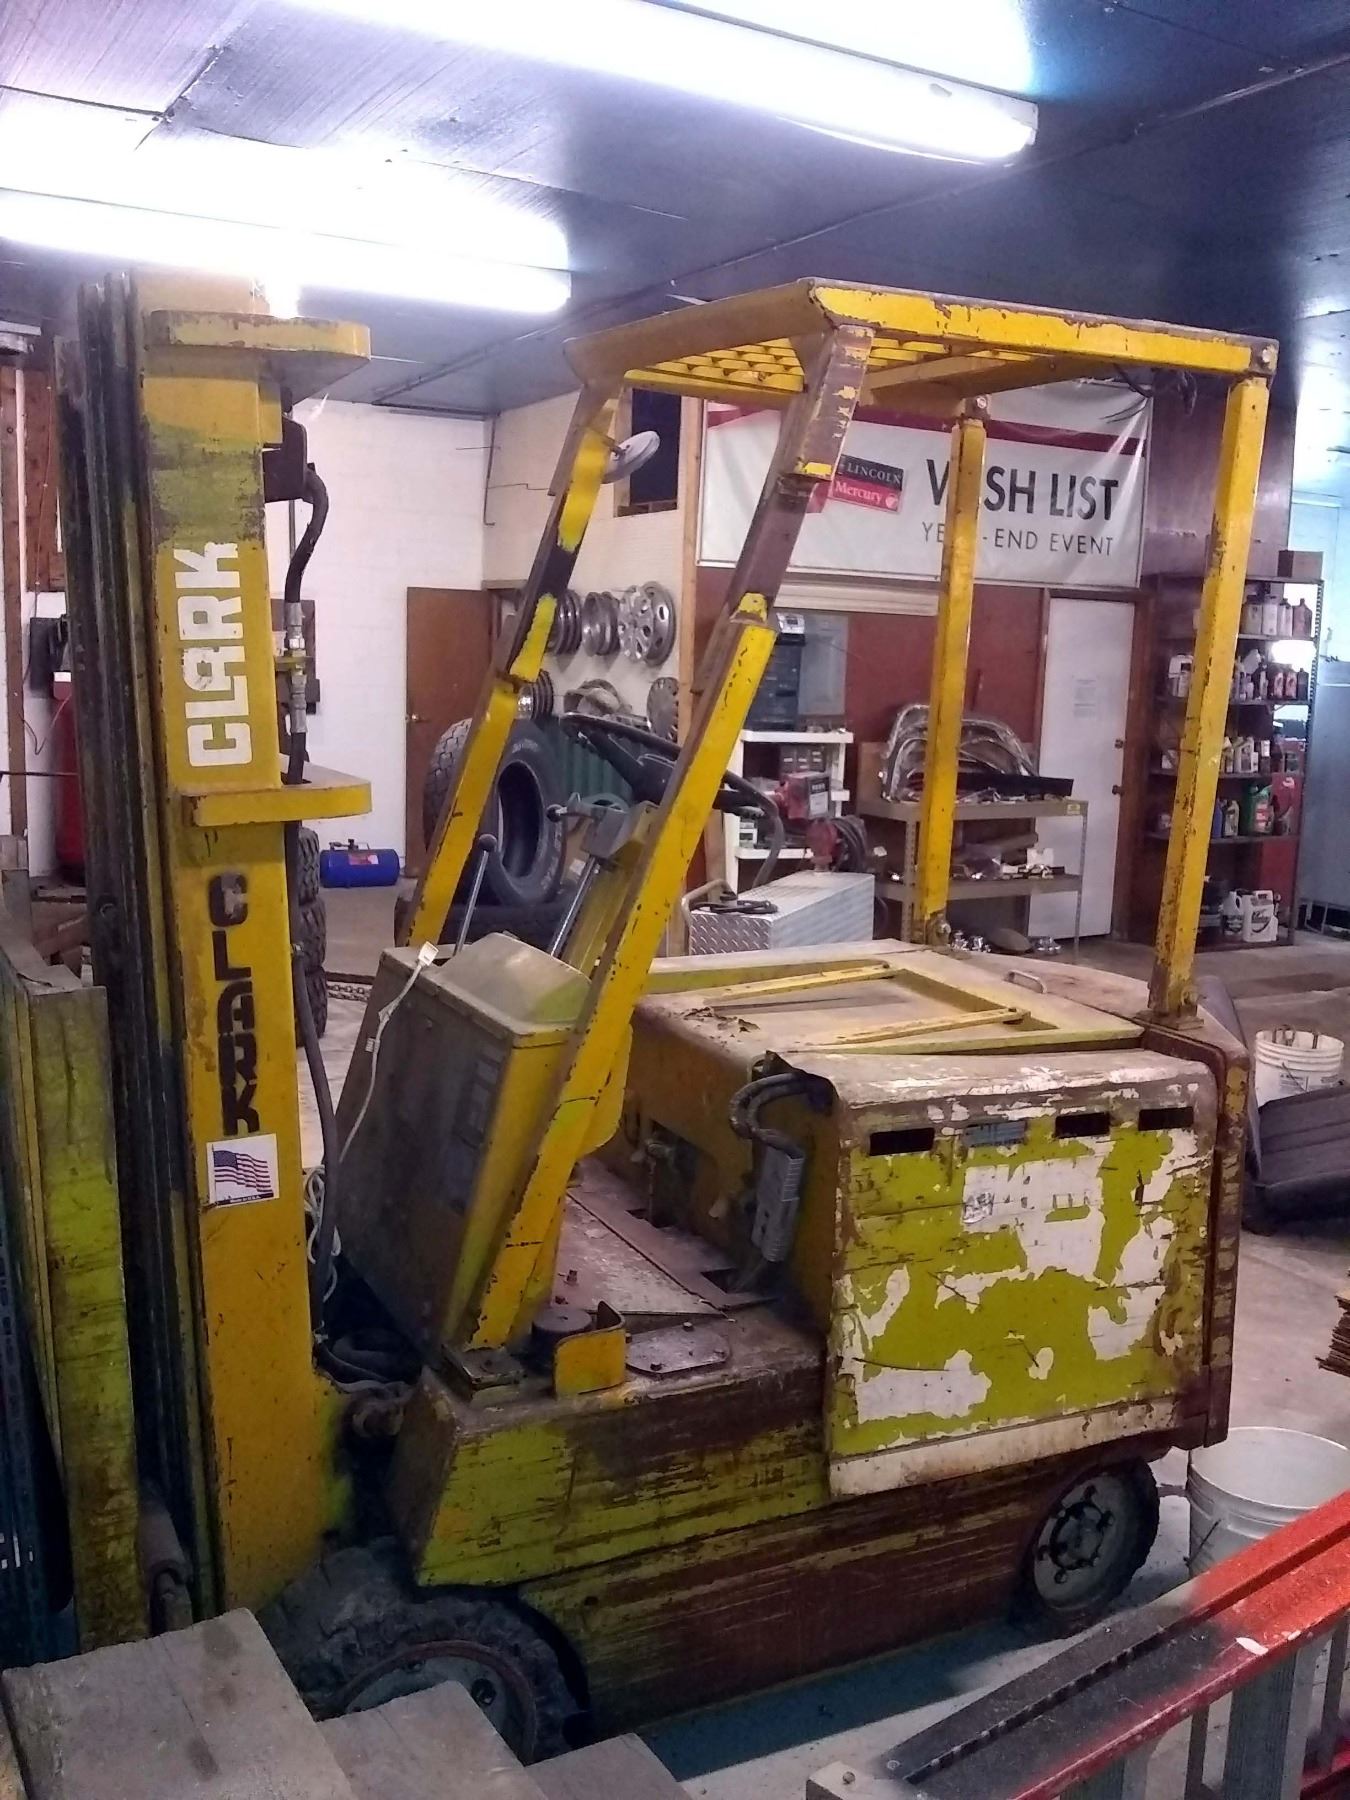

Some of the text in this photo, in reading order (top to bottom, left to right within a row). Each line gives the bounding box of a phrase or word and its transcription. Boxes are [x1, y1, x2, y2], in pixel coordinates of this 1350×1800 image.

[836, 481, 882, 505] Mercury
[847, 463, 901, 484] LINCOLN
[926, 458, 1119, 520] WSH LIST
[1050, 533, 1114, 556] EVENT
[173, 541, 253, 767] CLARK
[208, 874, 260, 1136] CLARK
